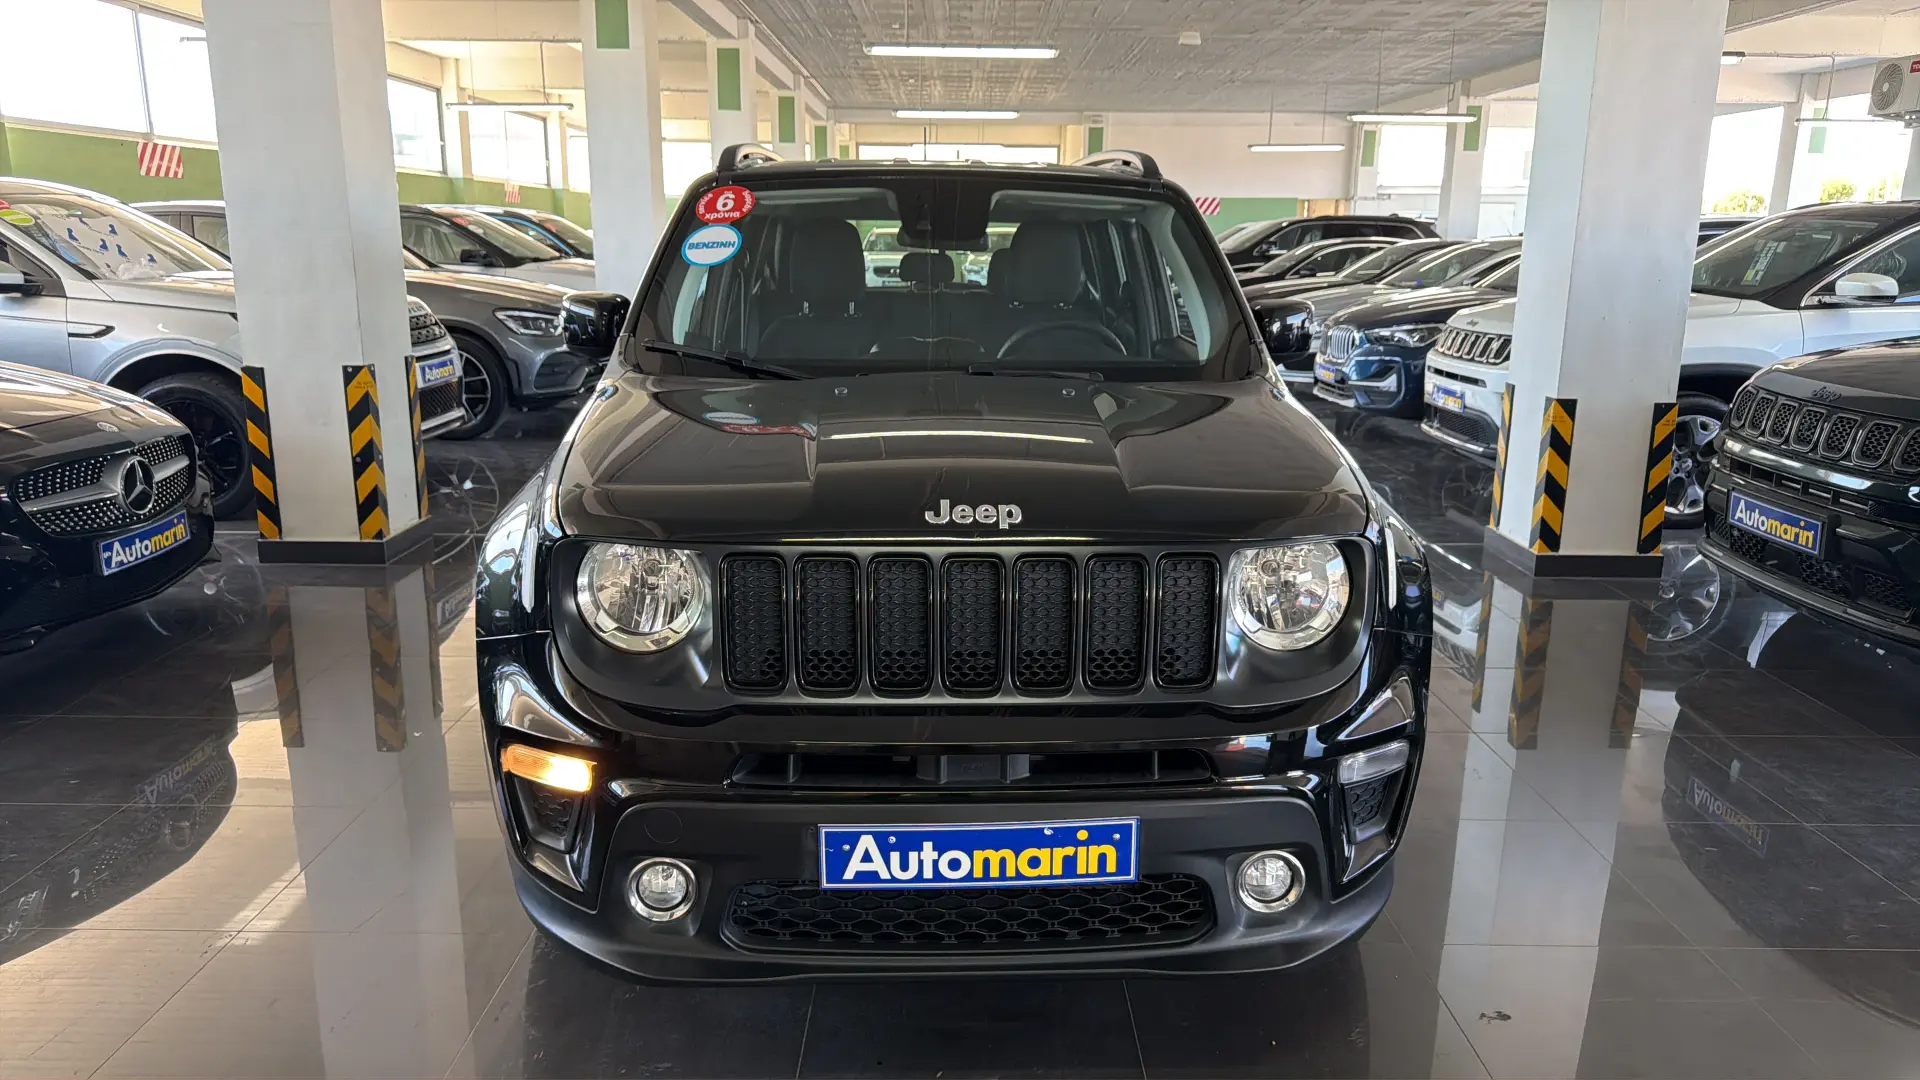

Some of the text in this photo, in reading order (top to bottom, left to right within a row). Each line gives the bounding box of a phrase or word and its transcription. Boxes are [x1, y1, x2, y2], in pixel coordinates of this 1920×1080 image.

[704, 211, 741, 220] χρόνια
[716, 193, 736, 212] 6
[925, 499, 1022, 529] Jeep
[1734, 499, 1814, 548] Automarin
[111, 518, 187, 568] Automarin
[842, 829, 1117, 880] Automarin
